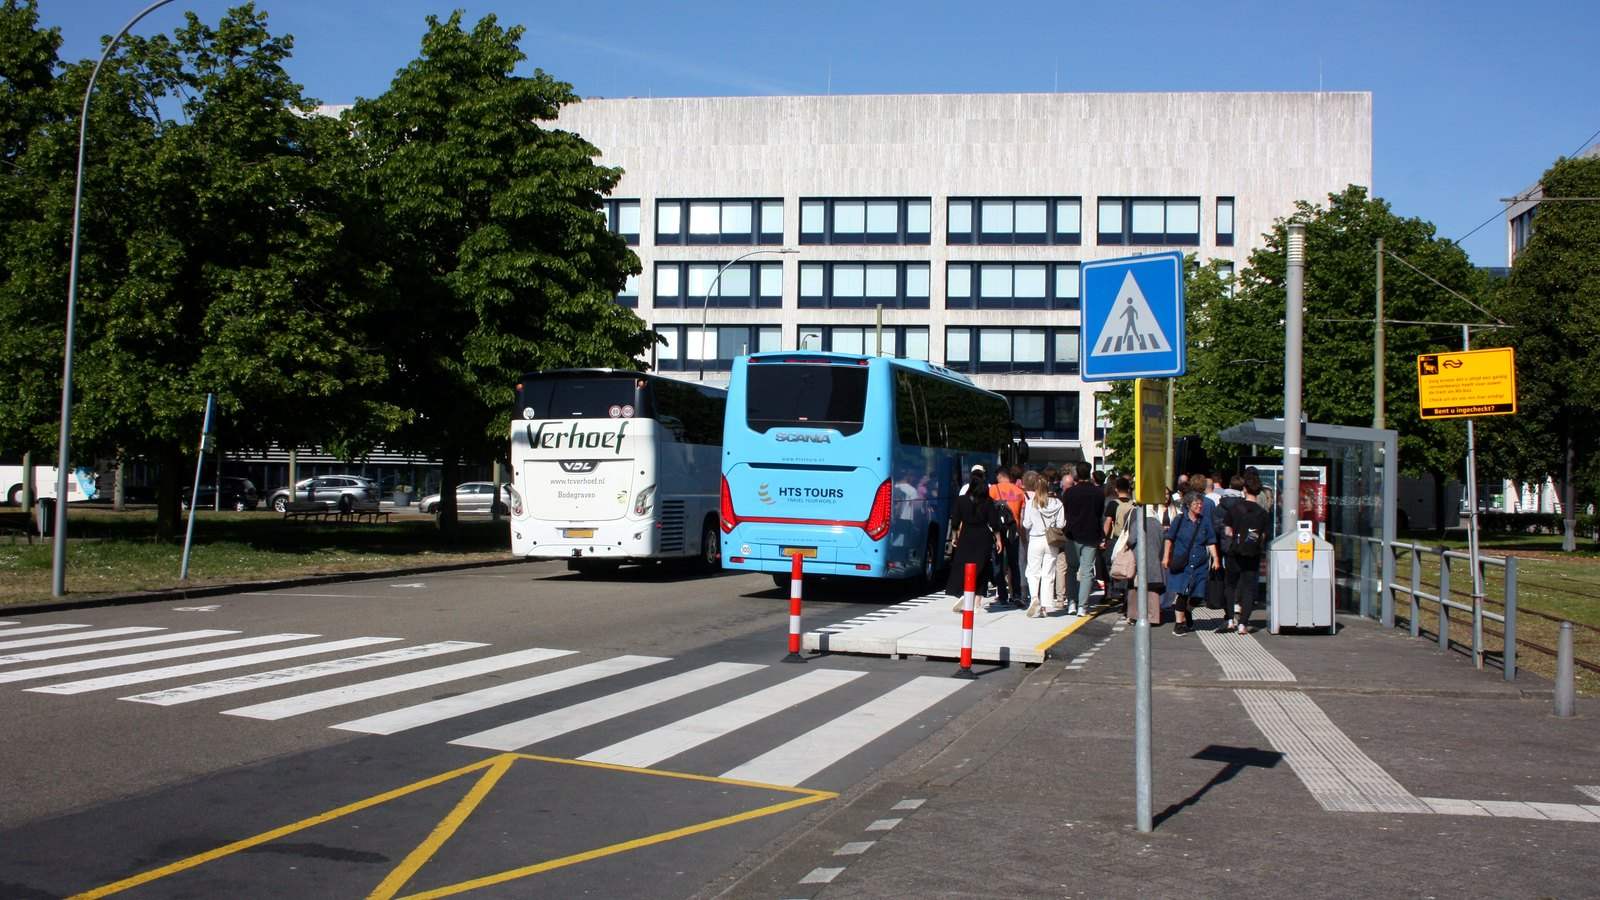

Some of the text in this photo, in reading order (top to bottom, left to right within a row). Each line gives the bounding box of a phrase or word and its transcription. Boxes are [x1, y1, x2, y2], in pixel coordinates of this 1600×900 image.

[1456, 405, 1495, 415] ingecheckt?
[526, 421, 629, 455] Verhoef
[775, 432, 831, 444] SCANIA
[563, 462, 593, 471] VDL
[558, 491, 596, 500] Bodegraven
[779, 487, 844, 498] HTS TOURS
